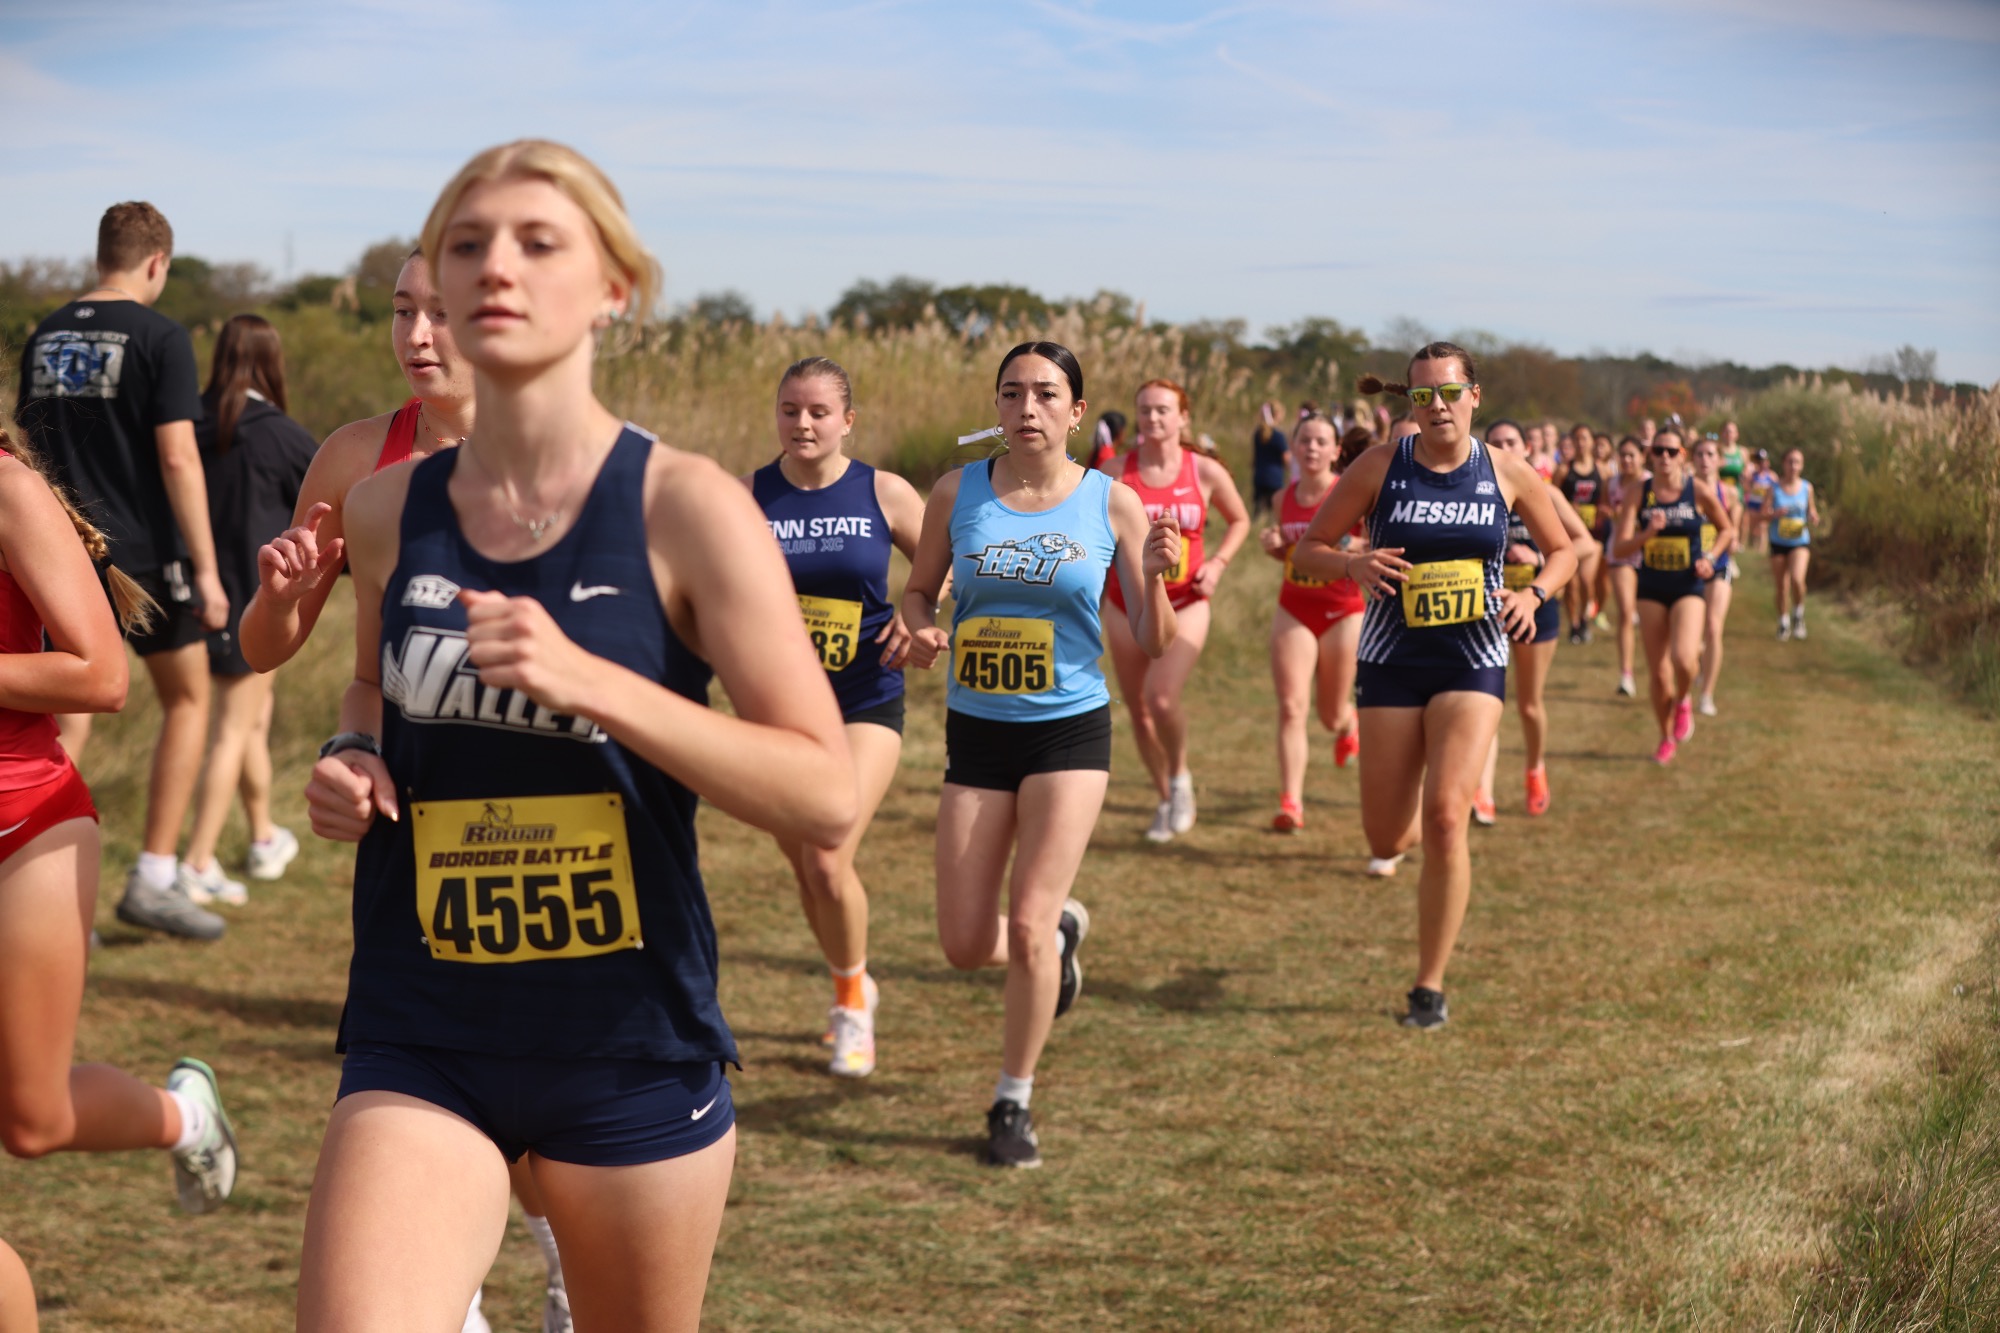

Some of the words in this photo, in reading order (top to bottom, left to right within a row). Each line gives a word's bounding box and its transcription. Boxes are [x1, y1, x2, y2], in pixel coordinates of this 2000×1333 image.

[1389, 500, 1496, 525] MESSIAH
[809, 516, 872, 538] STATE
[820, 537, 844, 552] XC
[976, 546, 1062, 585] HFU
[1408, 581, 1444, 590] BORDER
[1446, 578, 1479, 587] BATTLE
[1415, 588, 1476, 622] 4577
[811, 619, 853, 630] BATTLE
[977, 627, 1021, 639] Rowan
[810, 630, 850, 667] 83
[962, 639, 1001, 649] BORDER
[1003, 640, 1047, 650] BATTLE
[960, 651, 1047, 690] 4505
[462, 822, 557, 845] Rowan
[429, 850, 519, 869] BORDER
[523, 842, 615, 865] BATTLE
[432, 868, 624, 956] 4555
